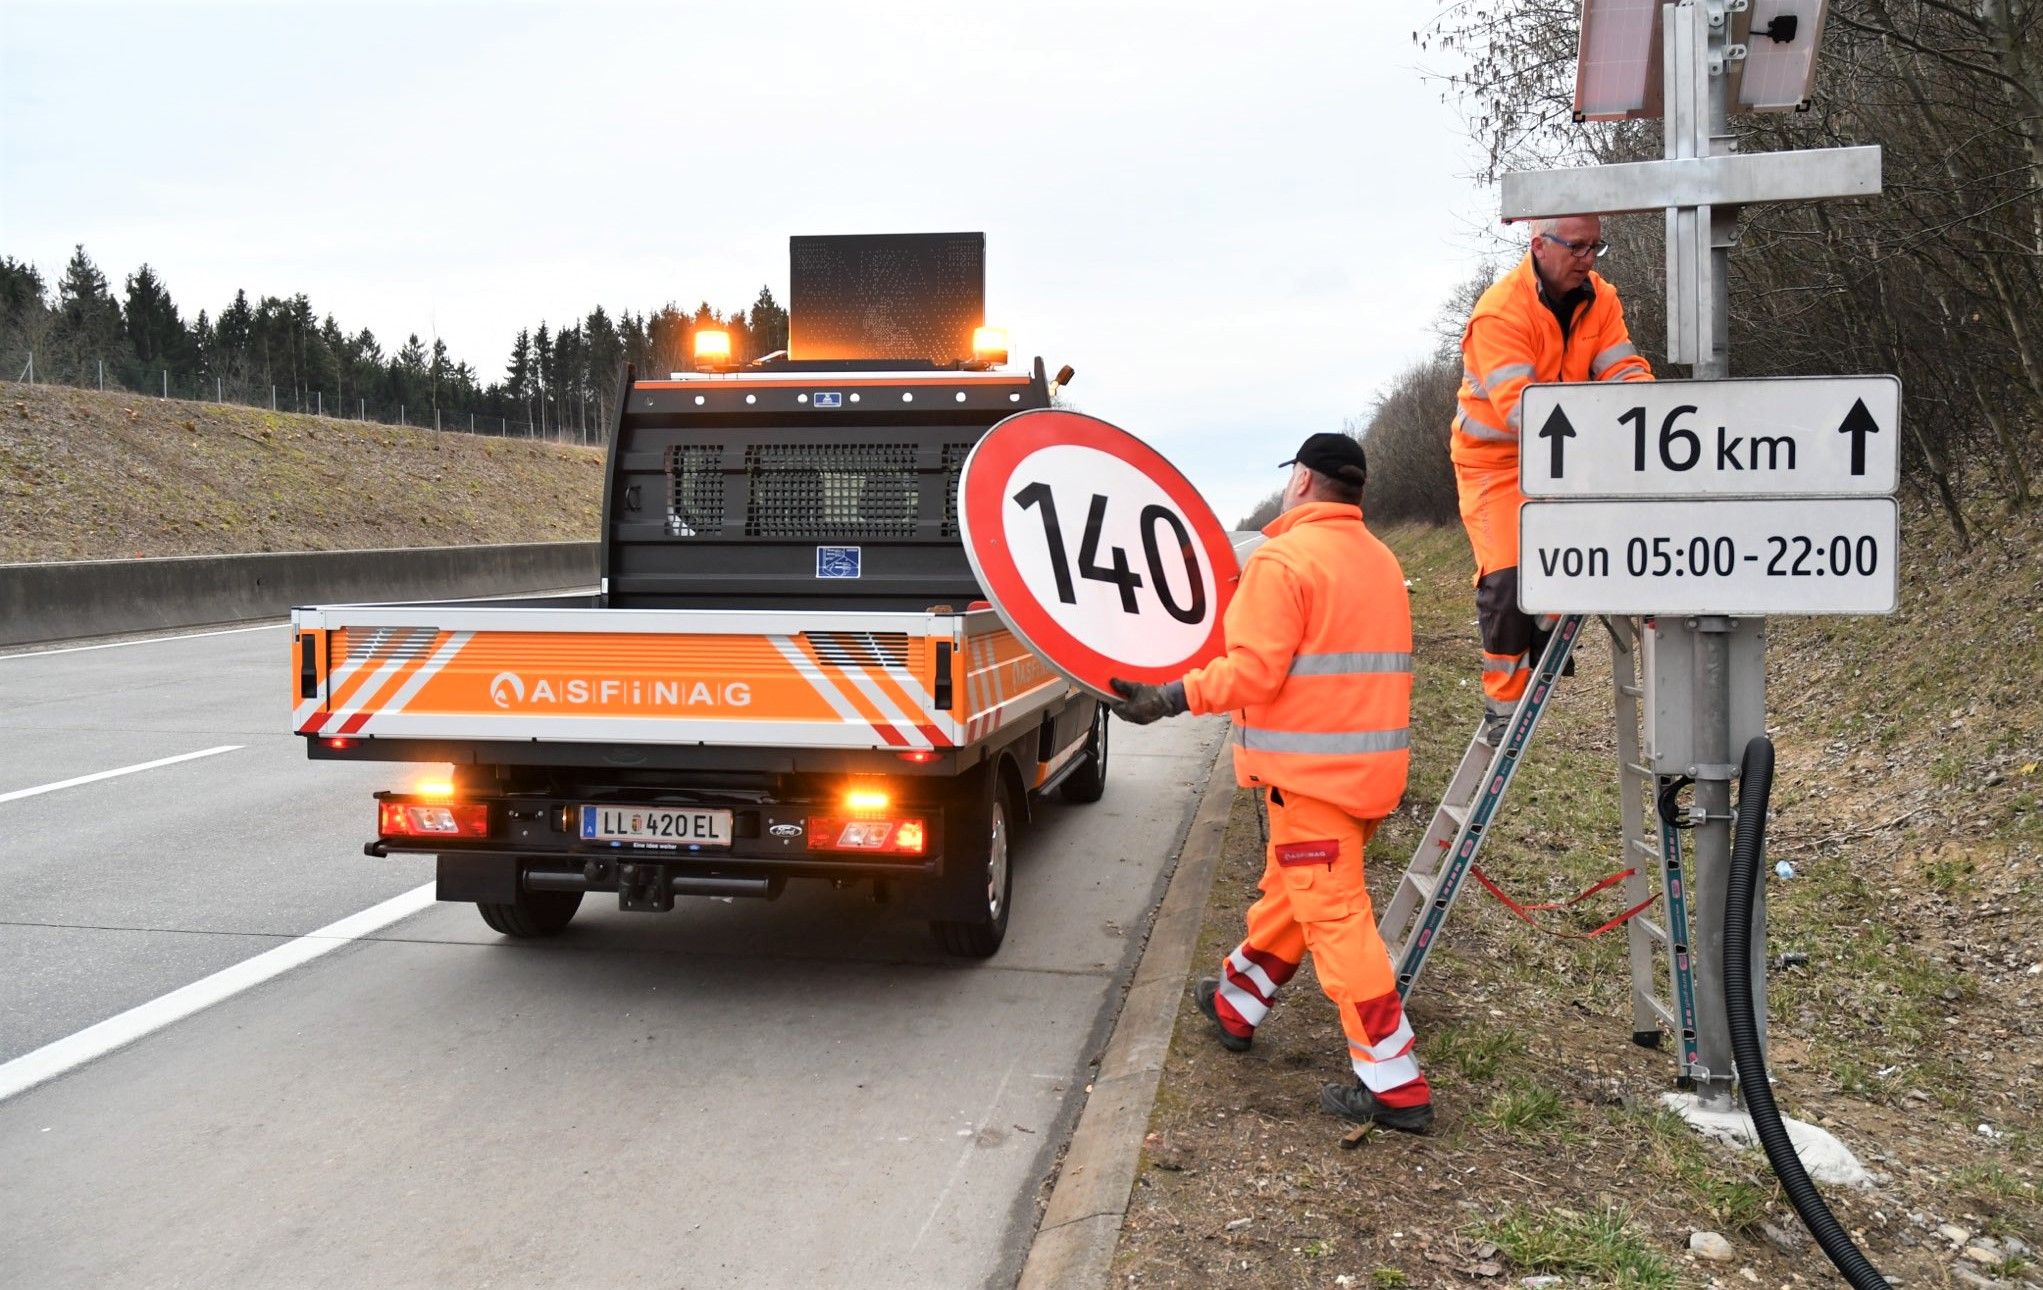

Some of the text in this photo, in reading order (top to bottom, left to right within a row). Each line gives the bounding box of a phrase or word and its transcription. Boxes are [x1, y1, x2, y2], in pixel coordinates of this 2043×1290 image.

[1616, 404, 1797, 472] 16 km
[1012, 481, 1206, 625] 140
[1538, 546, 1609, 577] von
[603, 811, 628, 835] LL
[646, 812, 688, 838] 420
[693, 814, 720, 839] EL
